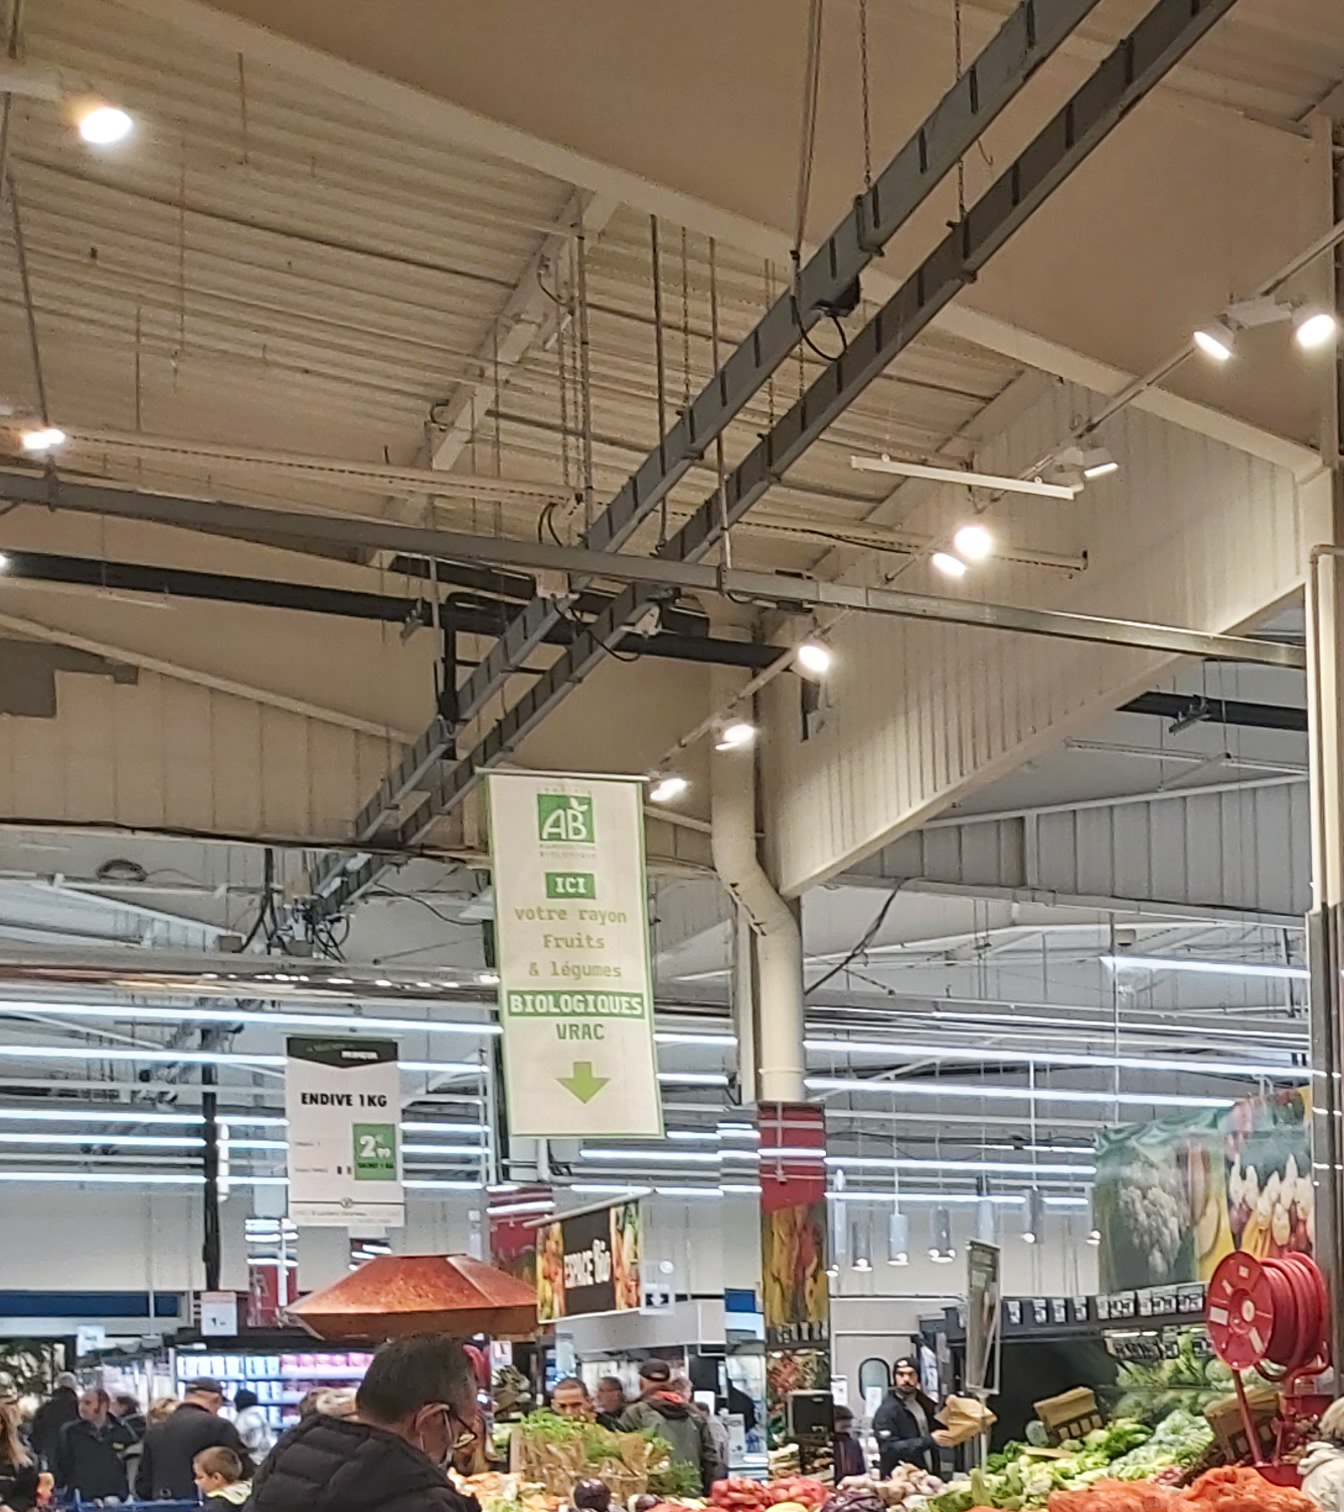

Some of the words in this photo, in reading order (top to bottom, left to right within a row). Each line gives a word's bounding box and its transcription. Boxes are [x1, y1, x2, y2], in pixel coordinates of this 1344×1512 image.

[541, 808, 588, 840] AB
[554, 877, 587, 894] ICI
[515, 906, 567, 921] votre
[579, 910, 627, 925] rayon
[543, 933, 605, 949] Fruits
[550, 961, 622, 981] légumes
[509, 994, 643, 1016] BIOLOGIQUES
[555, 1023, 606, 1041] VRAC
[300, 1092, 354, 1107] ENDIVE
